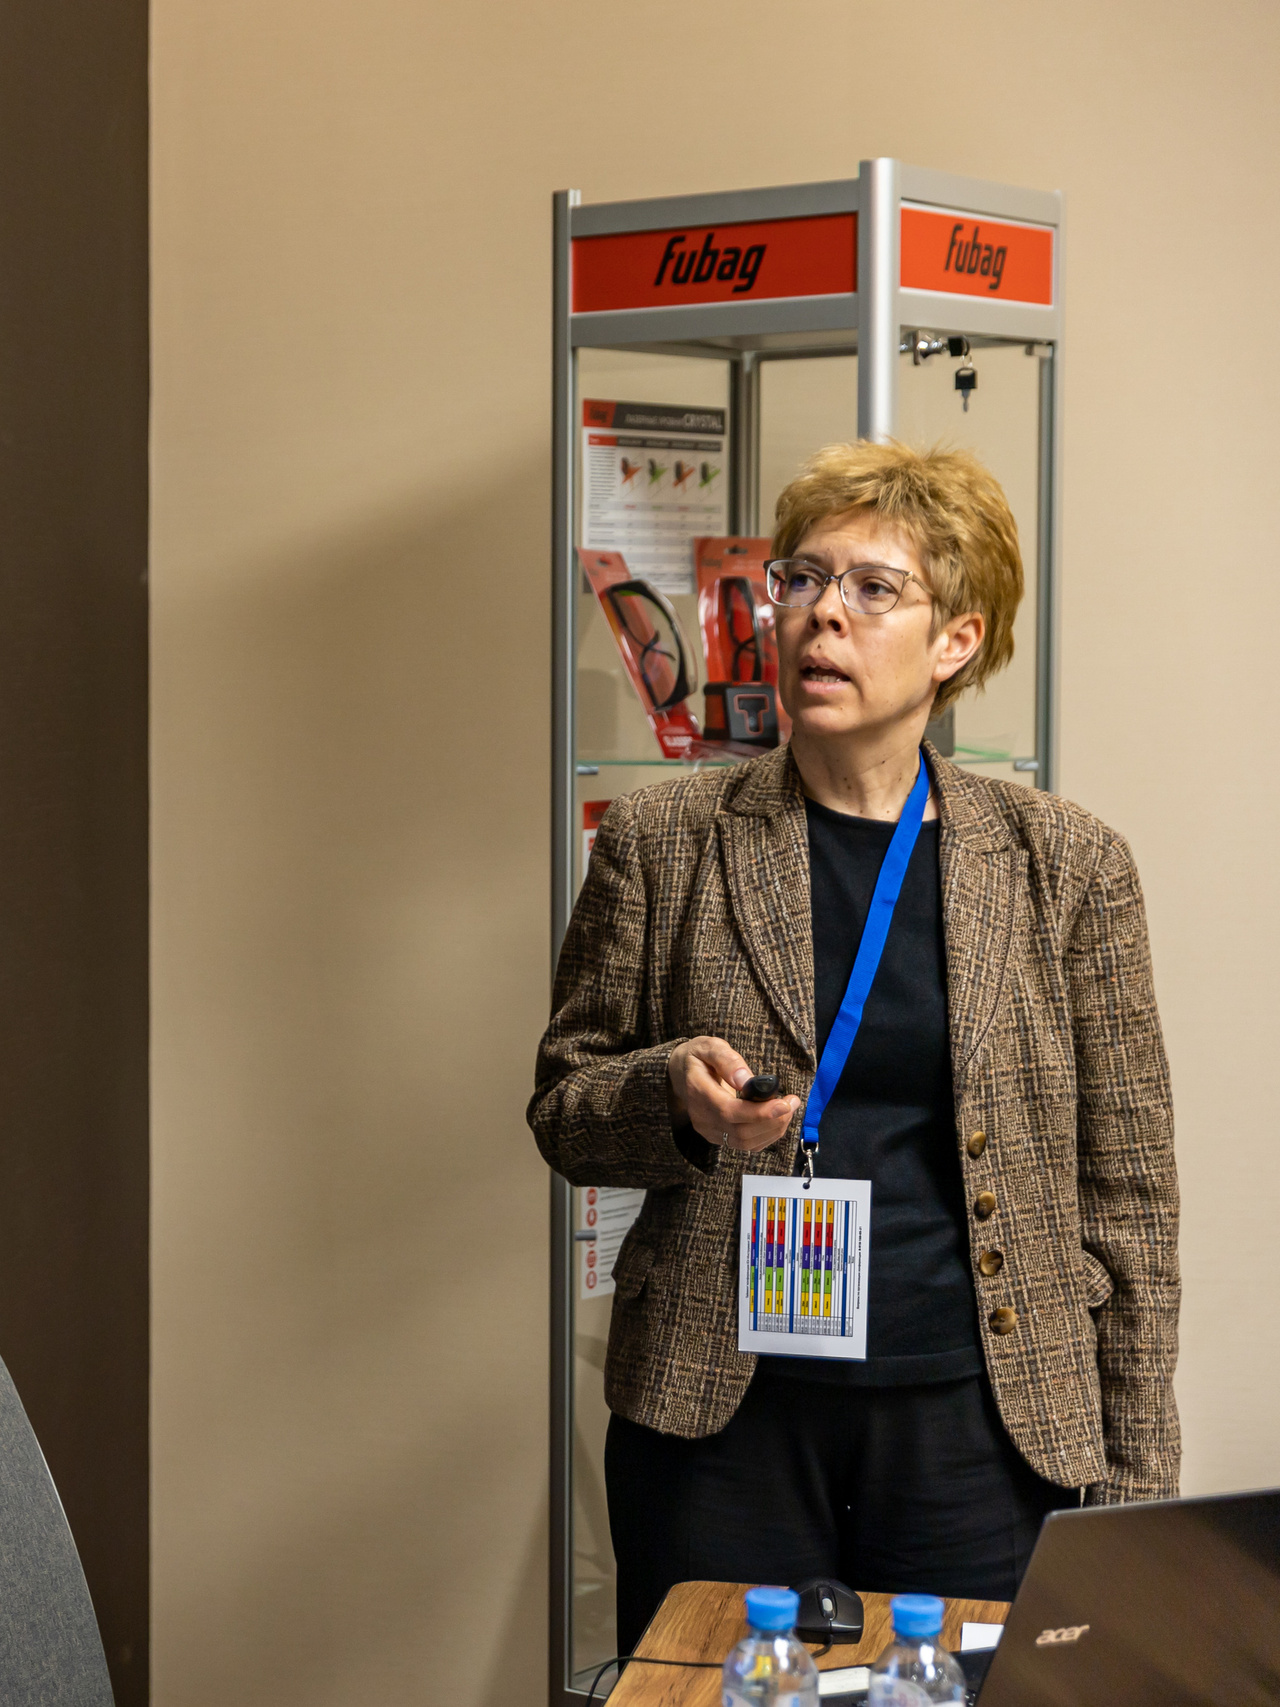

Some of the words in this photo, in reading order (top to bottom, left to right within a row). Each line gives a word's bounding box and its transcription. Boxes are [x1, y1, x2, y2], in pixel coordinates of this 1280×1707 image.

[654, 232, 768, 293] fubag
[943, 223, 1008, 290] fubag
[1036, 1624, 1090, 1645] acer
